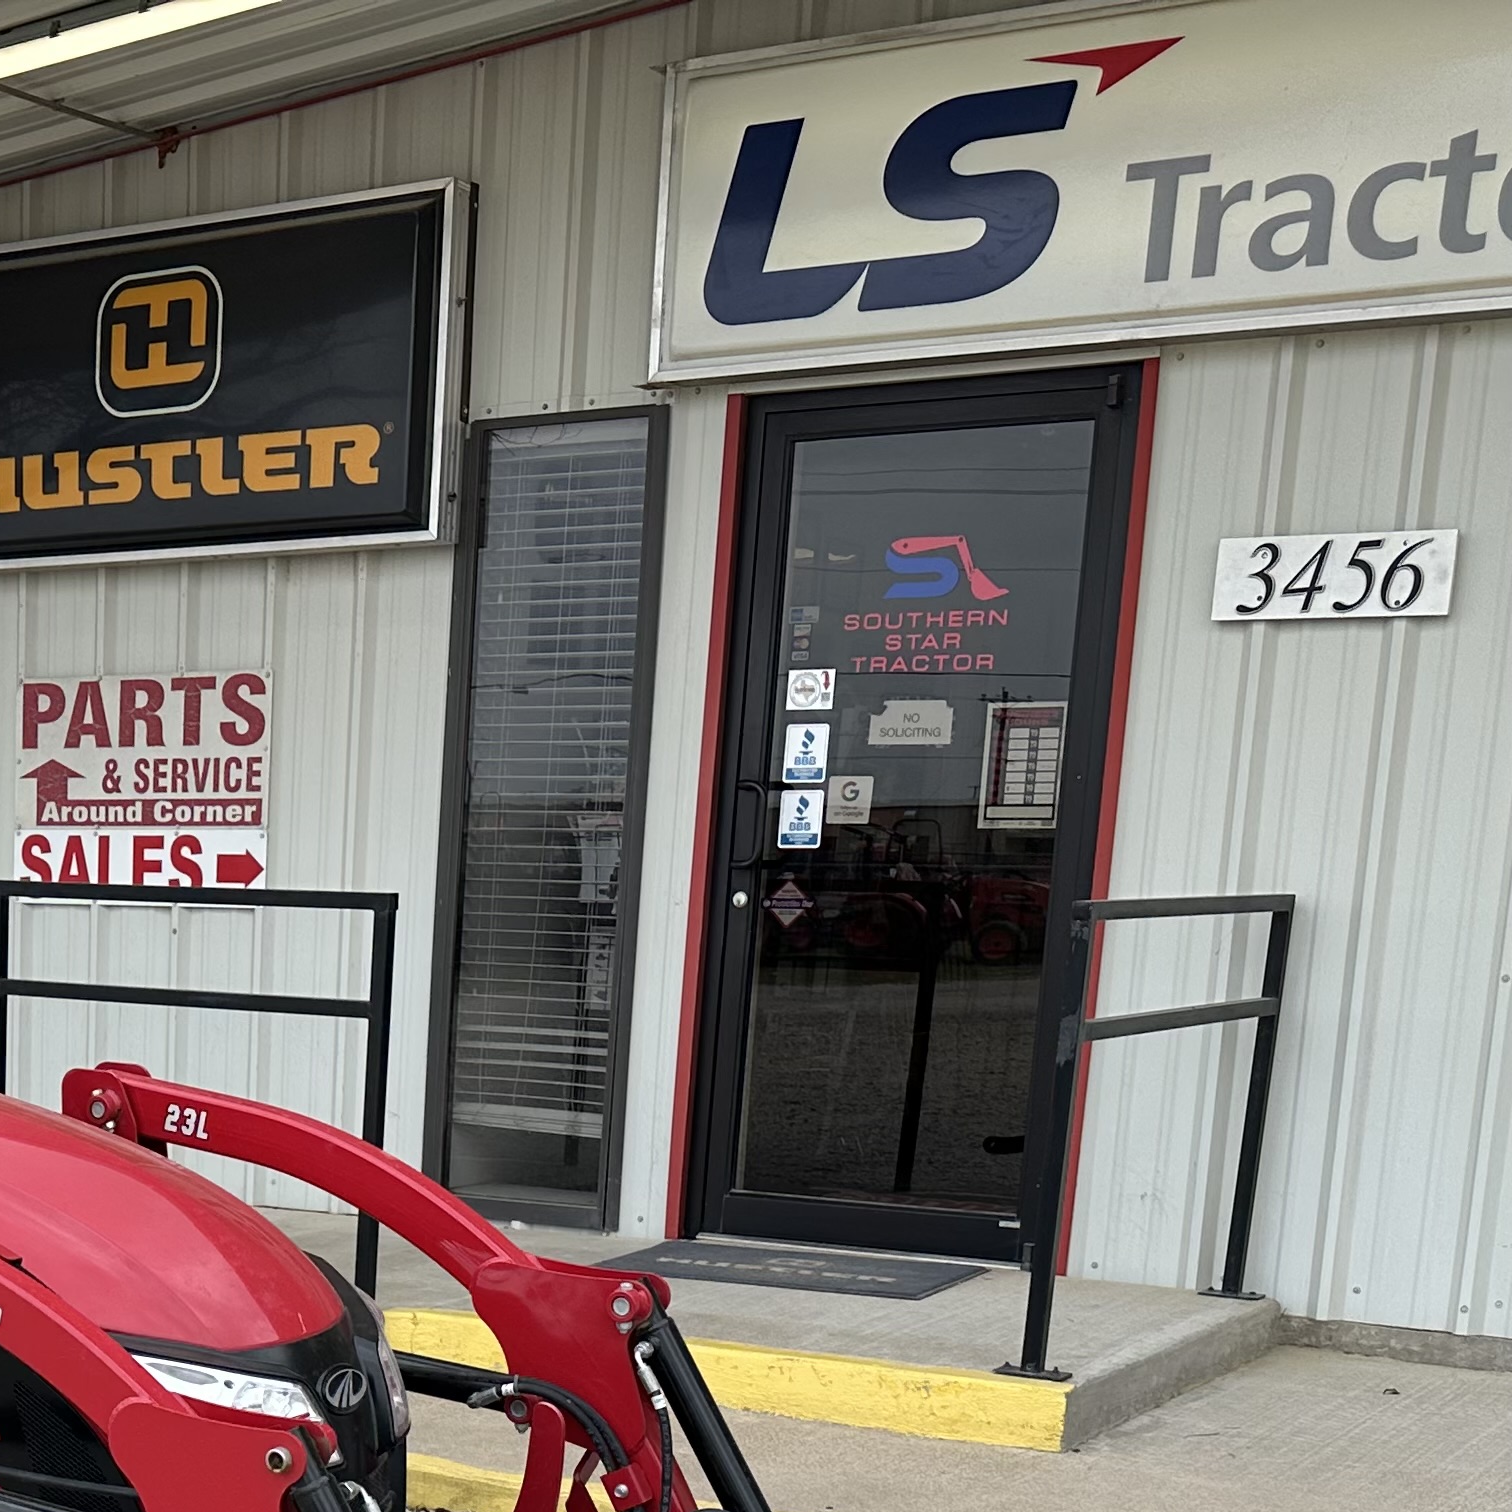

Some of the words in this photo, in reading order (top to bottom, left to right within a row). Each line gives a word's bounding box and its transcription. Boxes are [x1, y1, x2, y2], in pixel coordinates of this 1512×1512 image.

[703, 79, 1078, 326] LS
[1125, 129, 1512, 283] Tract
[1236, 538, 1434, 613] 3456
[844, 609, 1009, 630] SOUTHERN
[885, 633, 961, 651] STAR
[851, 654, 994, 673] TRACTOR
[22, 673, 266, 749] PARTS
[903, 713, 920, 723] NO
[879, 727, 941, 738] SOLICITING
[102, 759, 122, 793] &
[134, 757, 262, 793] SERVICE
[41, 801, 142, 822] Around
[153, 801, 256, 822] Corner
[20, 834, 203, 888] SALES
[164, 1103, 208, 1140] 23L
